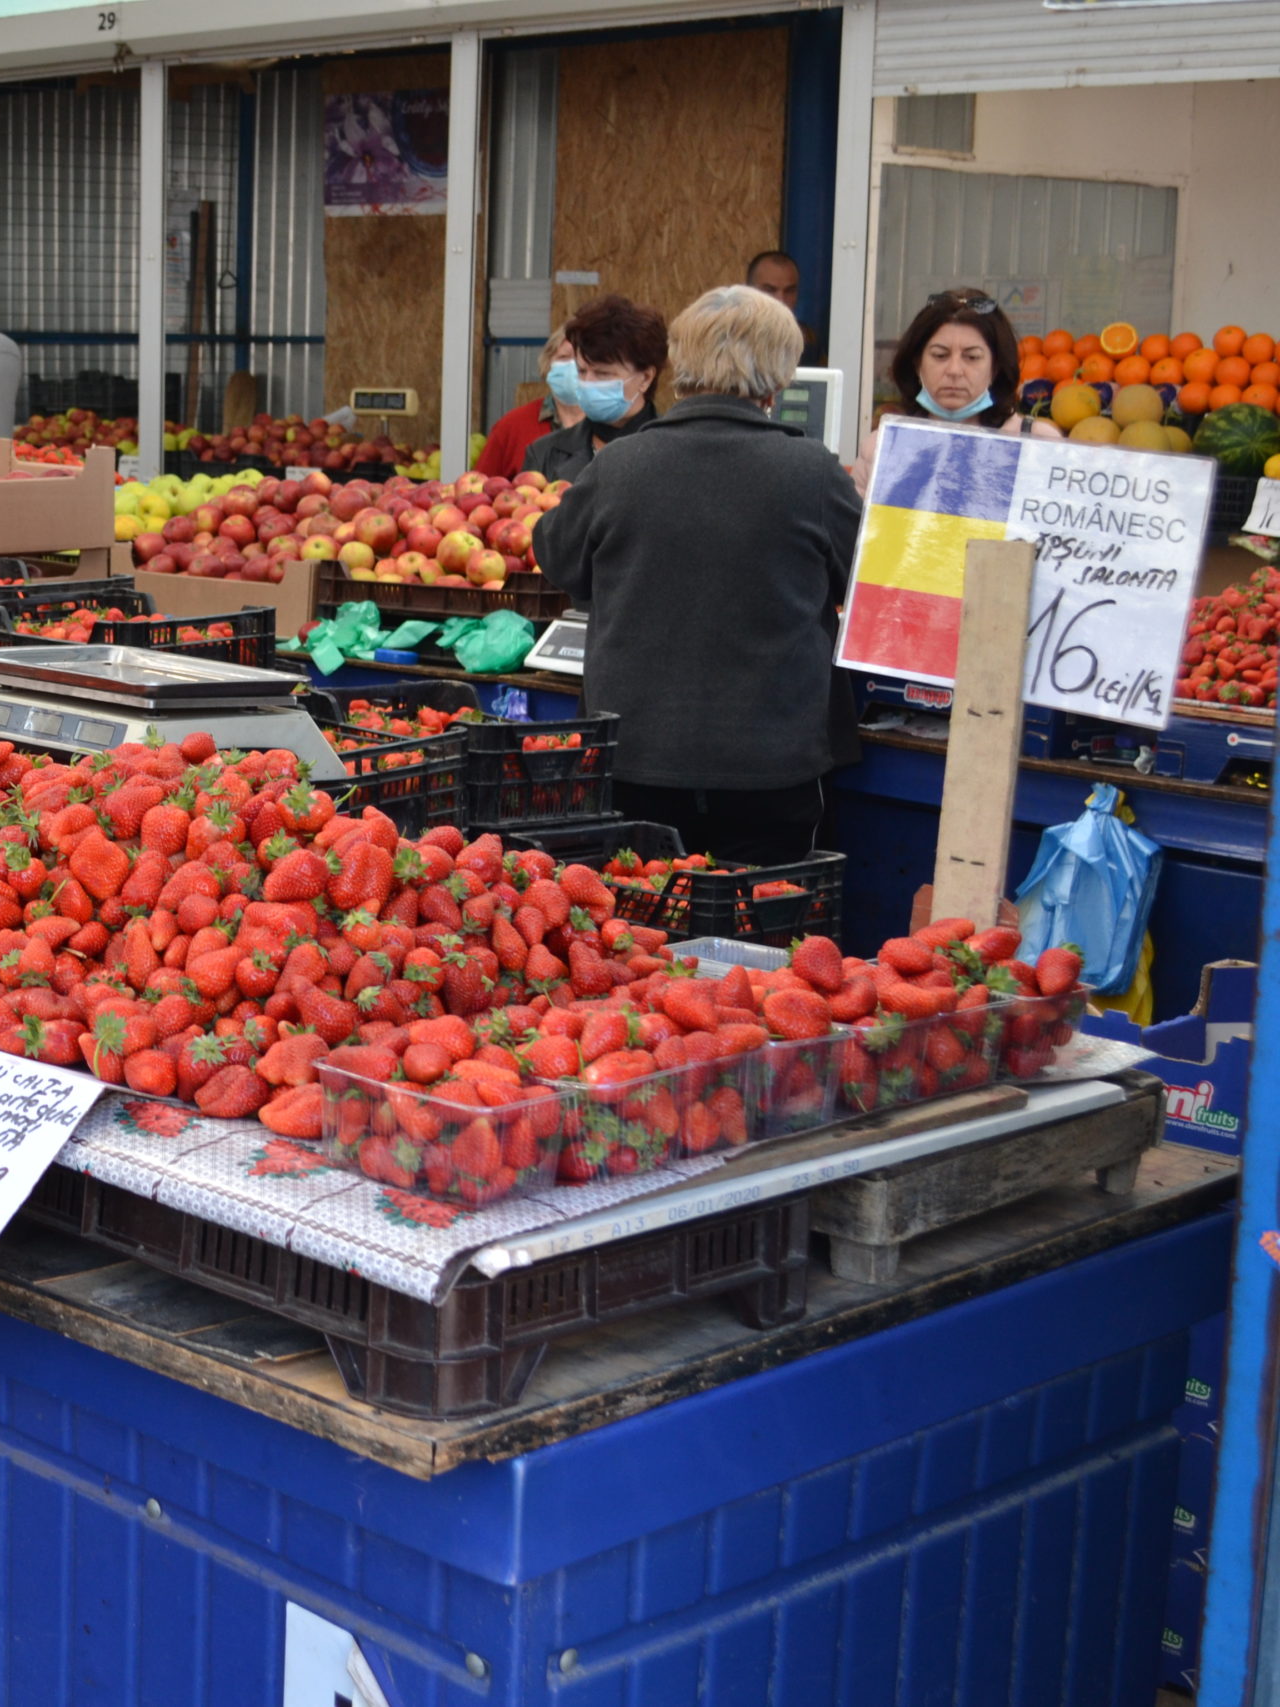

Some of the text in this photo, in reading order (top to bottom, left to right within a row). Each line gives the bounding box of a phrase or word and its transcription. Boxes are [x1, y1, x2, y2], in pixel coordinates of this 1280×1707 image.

[98, 12, 116, 31] 29
[1048, 466, 1171, 504] PRODUS
[1020, 500, 1187, 543] ROMÂNESC
[1073, 566, 1178, 592] SALONTA
[1027, 587, 1117, 694] 16
[1196, 1107, 1235, 1127] fruits
